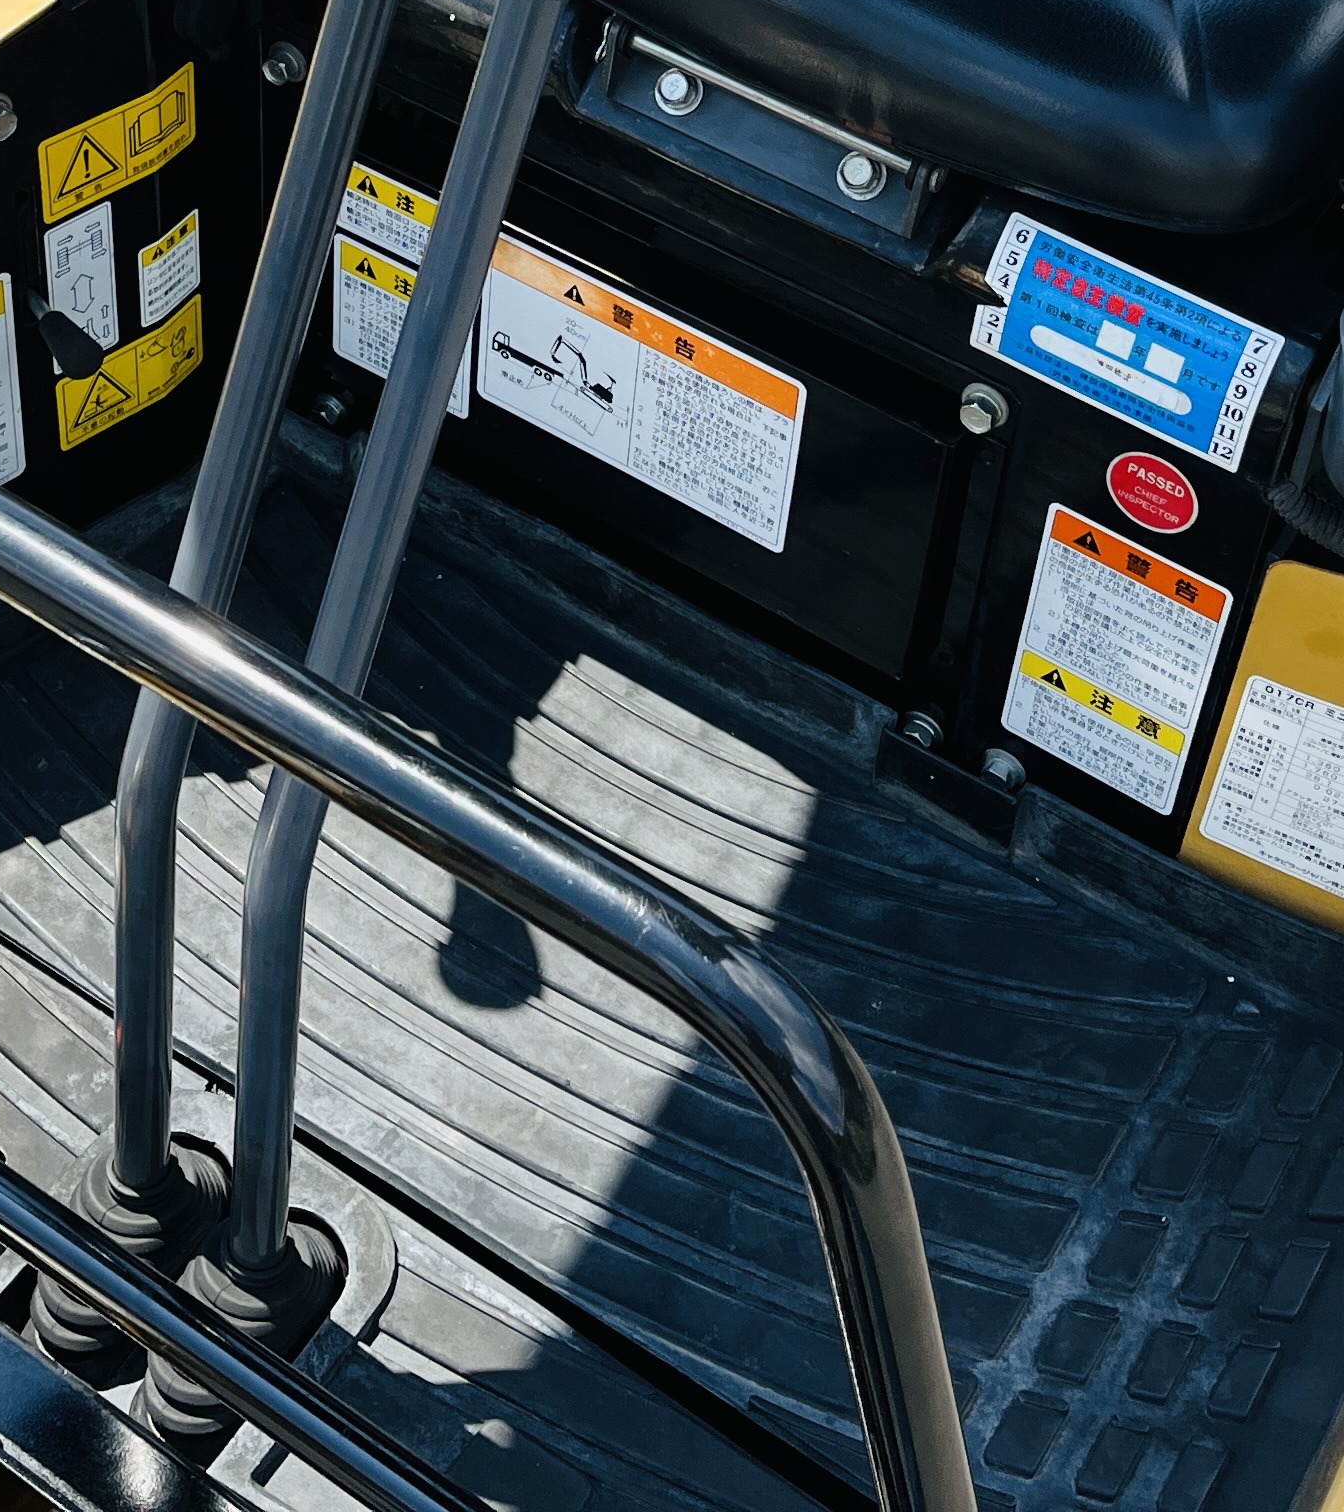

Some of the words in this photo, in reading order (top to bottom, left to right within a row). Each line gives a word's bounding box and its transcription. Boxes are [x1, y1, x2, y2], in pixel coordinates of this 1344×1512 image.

[1014, 227, 1030, 245] 6
[1005, 249, 1020, 267] 5
[997, 271, 1012, 289] 4
[986, 312, 1001, 328] 2
[983, 331, 994, 344] 1
[1251, 337, 1268, 356] 7
[1239, 359, 1258, 380] 8
[1231, 382, 1248, 401] 9
[1221, 403, 1244, 423] 10
[1216, 423, 1237, 442] 11
[1210, 440, 1233, 460] 12
[1127, 462, 1186, 499] PASSED
[1134, 485, 1168, 506] CHIEF
[1117, 488, 1180, 525] INSPECTOR
